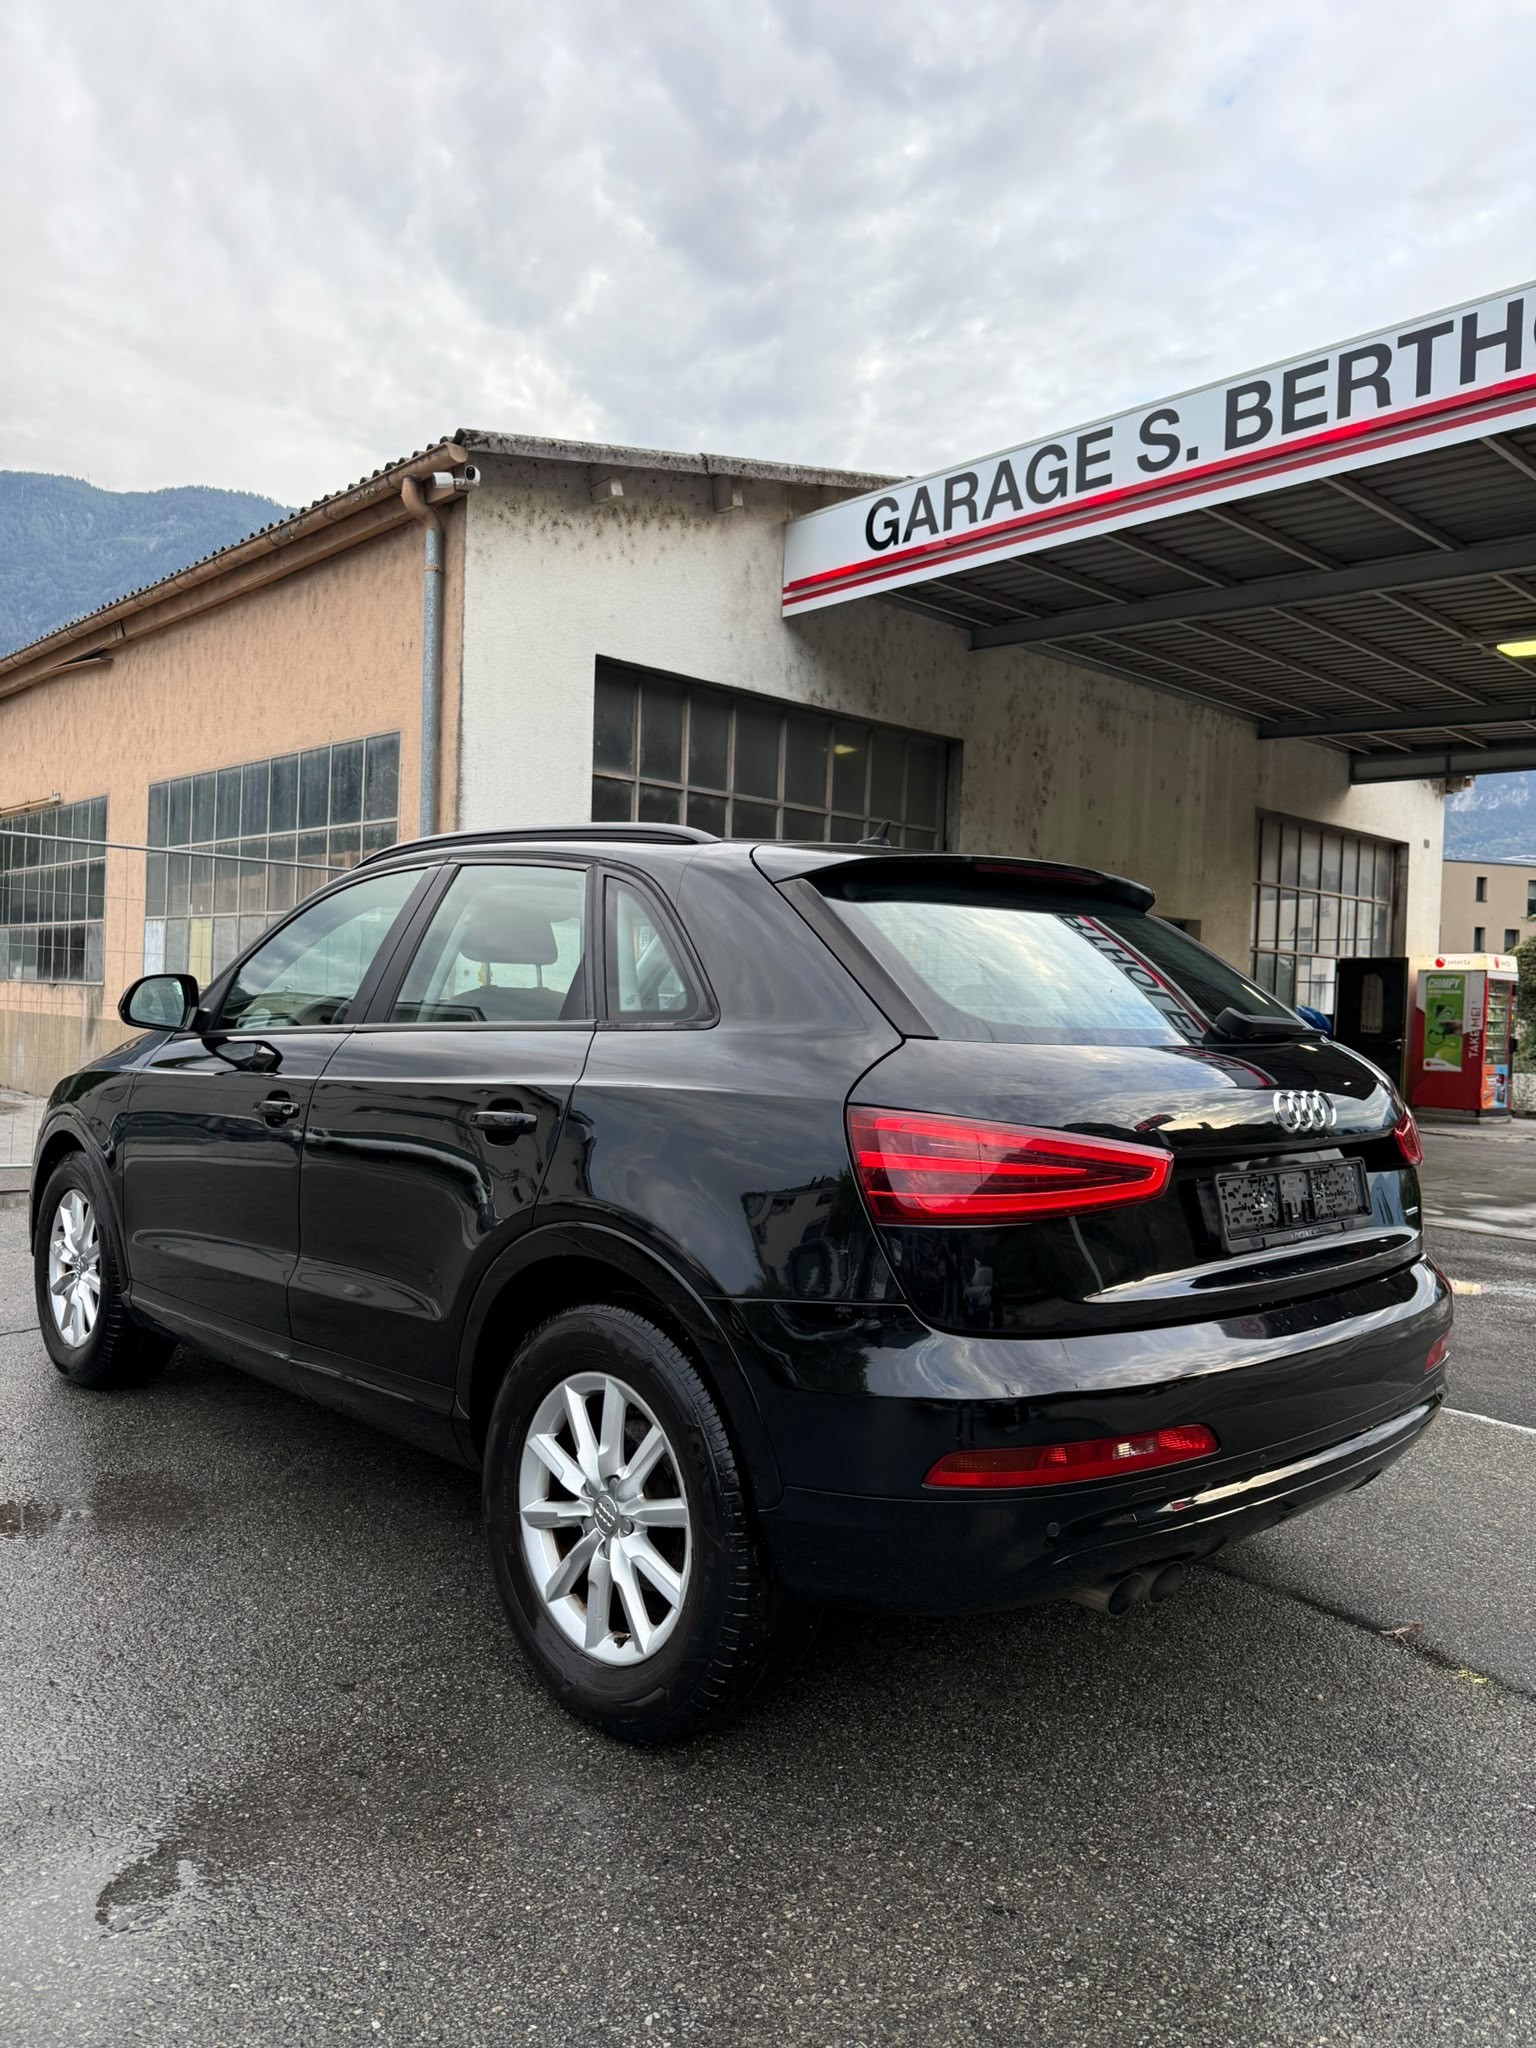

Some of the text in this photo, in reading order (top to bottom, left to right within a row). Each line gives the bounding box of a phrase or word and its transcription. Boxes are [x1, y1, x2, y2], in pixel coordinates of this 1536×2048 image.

[865, 298, 1536, 551] GARAGE S. BERTH
[1468, 1029, 1480, 1058] TAKE
